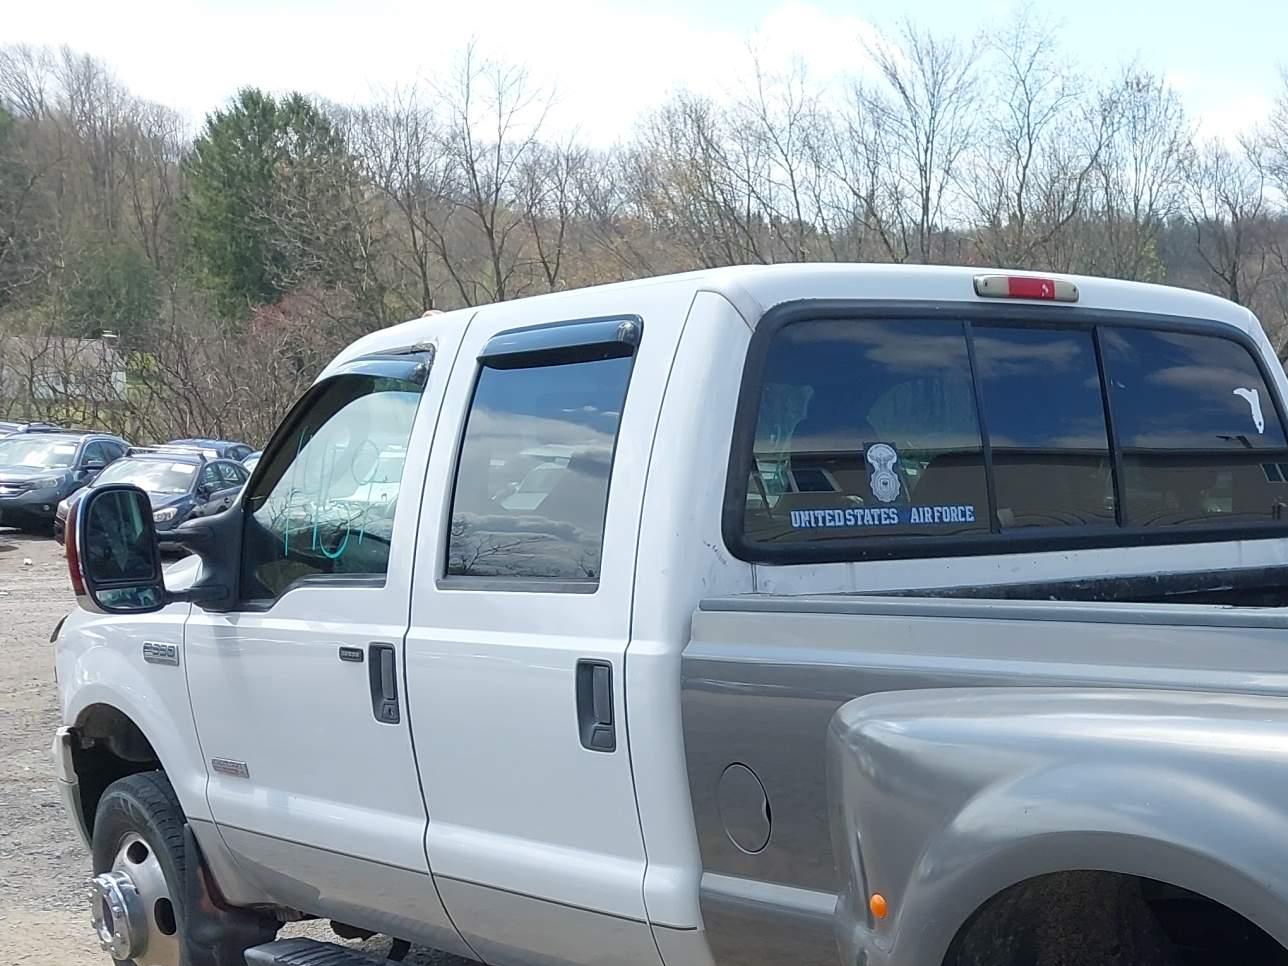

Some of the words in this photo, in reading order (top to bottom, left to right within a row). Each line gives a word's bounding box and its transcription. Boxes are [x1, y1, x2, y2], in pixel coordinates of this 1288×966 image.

[790, 509, 845, 527] UNITED
[844, 507, 899, 525] STATES
[910, 507, 935, 523] AIR
[934, 505, 975, 522] FORCE
